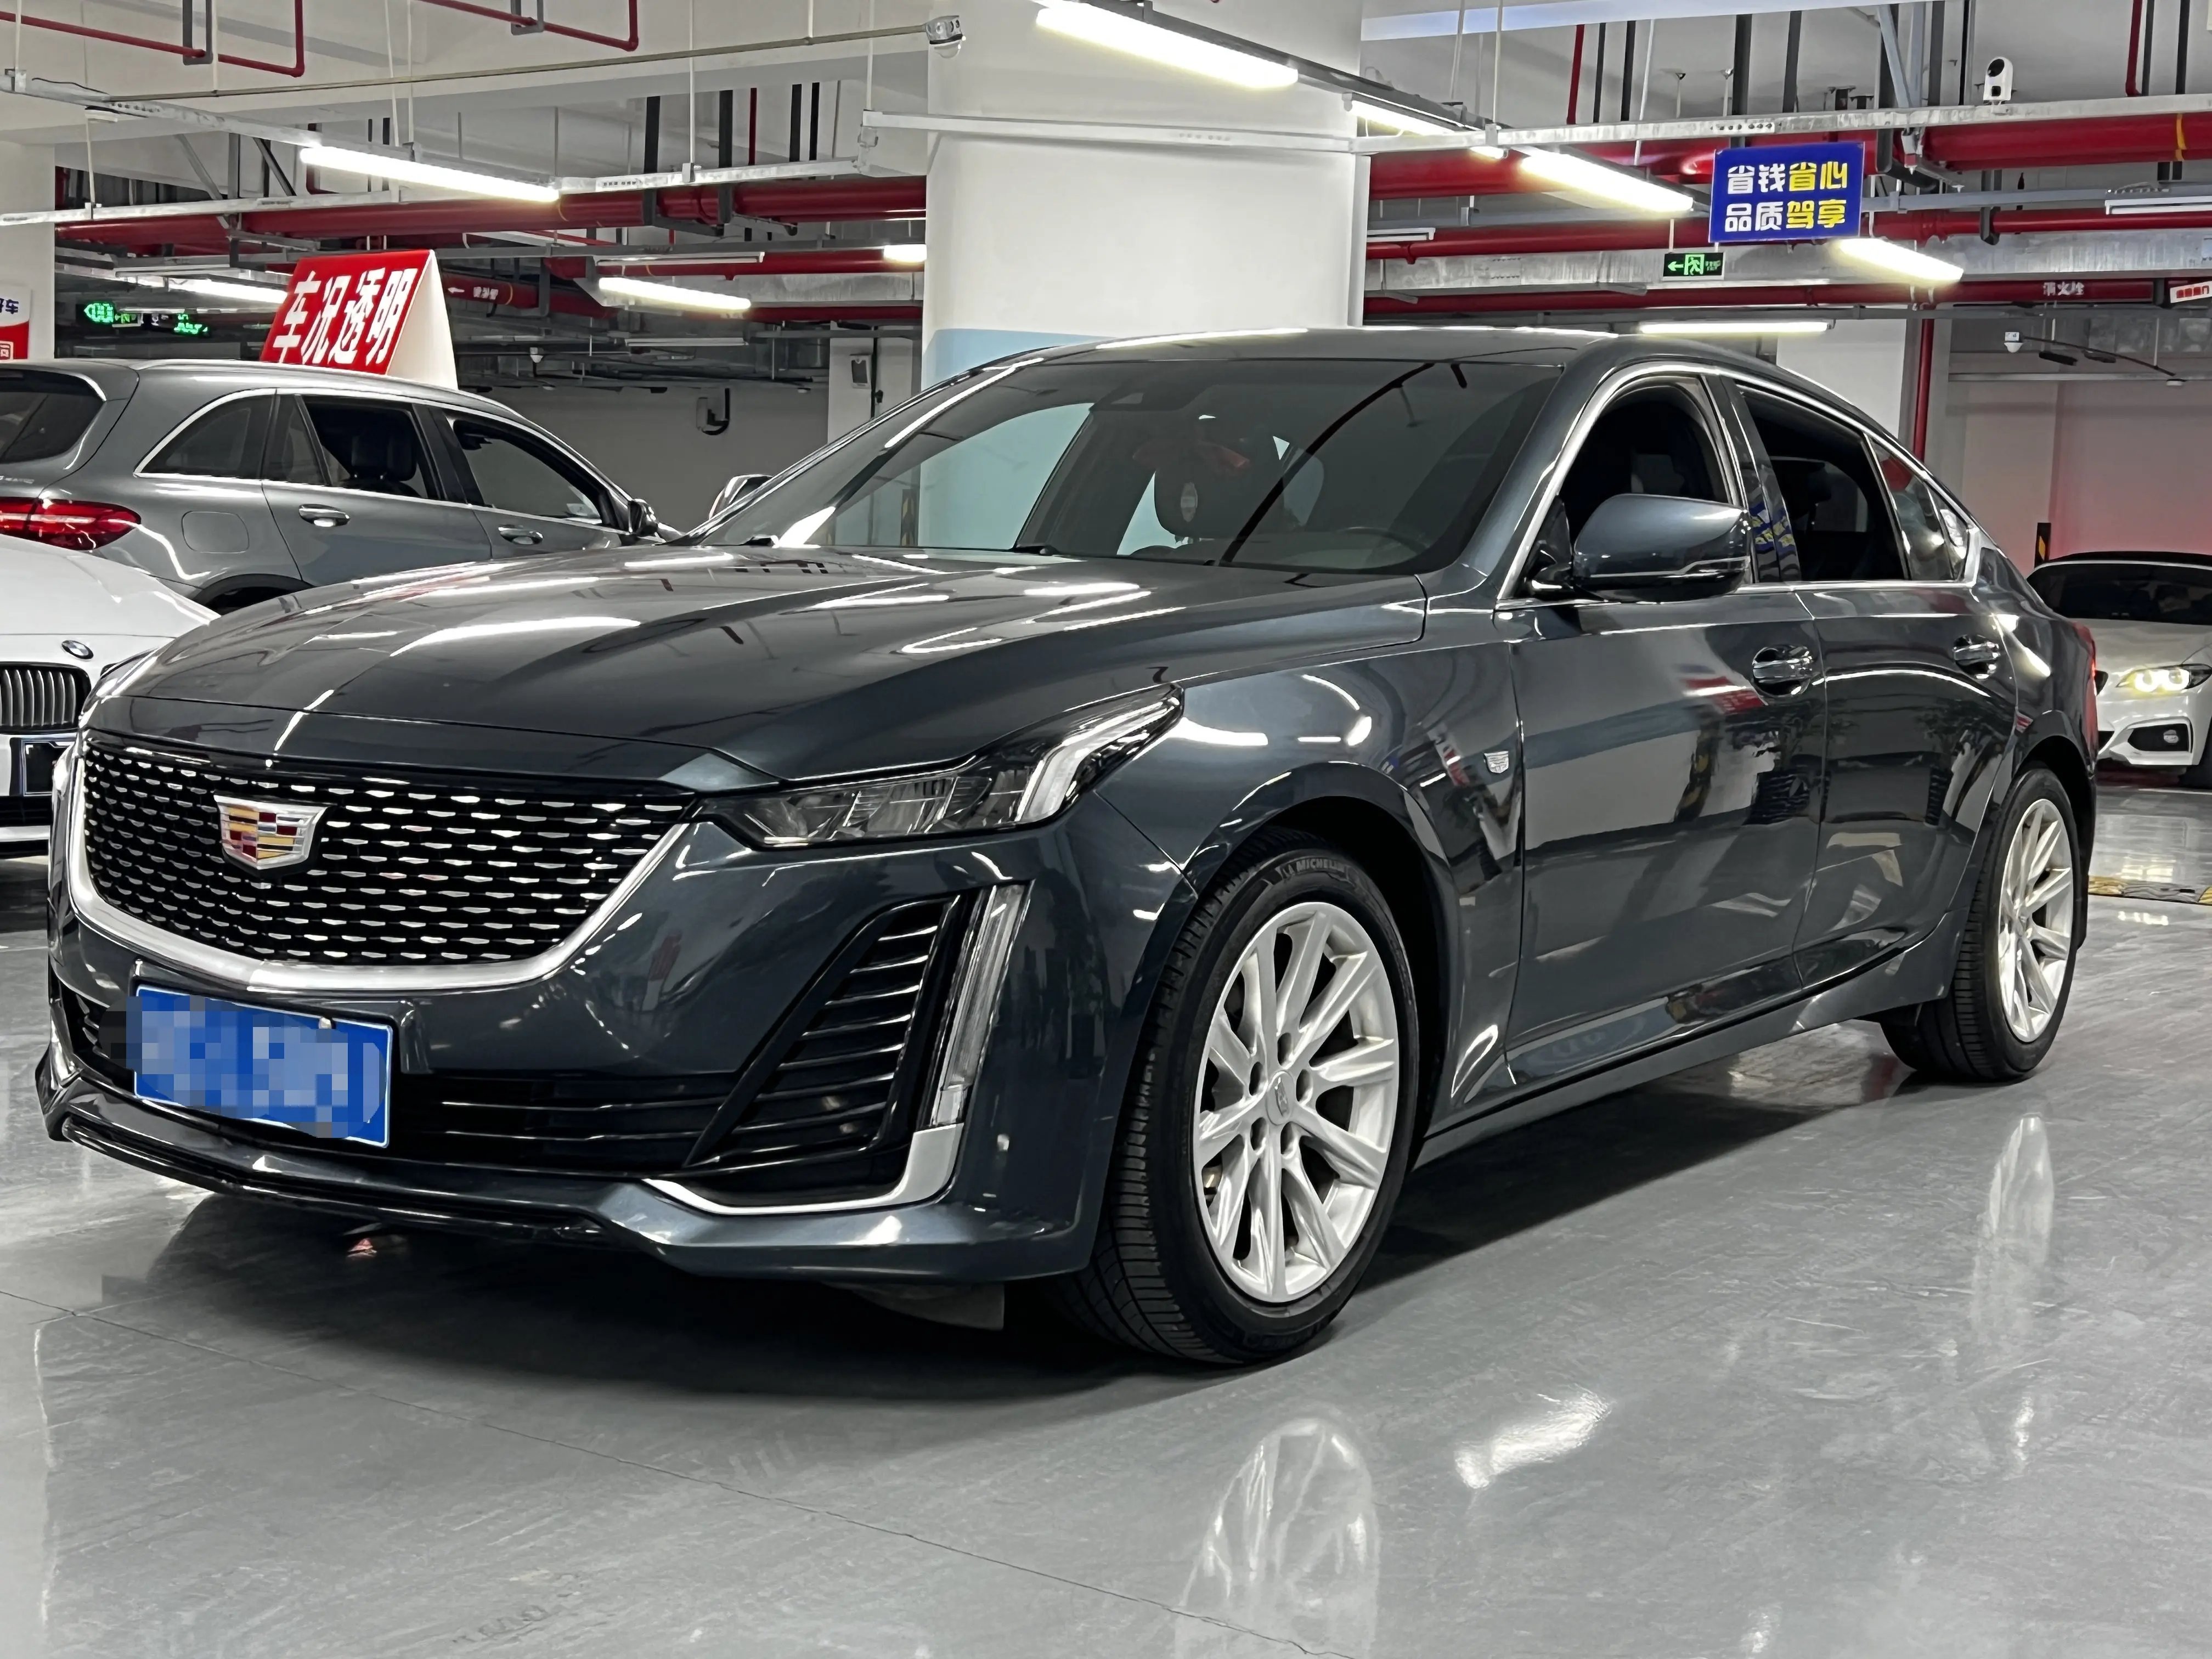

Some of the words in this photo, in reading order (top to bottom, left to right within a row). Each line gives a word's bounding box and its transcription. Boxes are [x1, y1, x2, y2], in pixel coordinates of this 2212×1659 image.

[1728, 161, 1848, 195] 省钱省心
[1725, 200, 1847, 233] 品质驾享
[273, 267, 418, 366] 车况透明
[1296, 858, 1345, 873] MICHELIN
